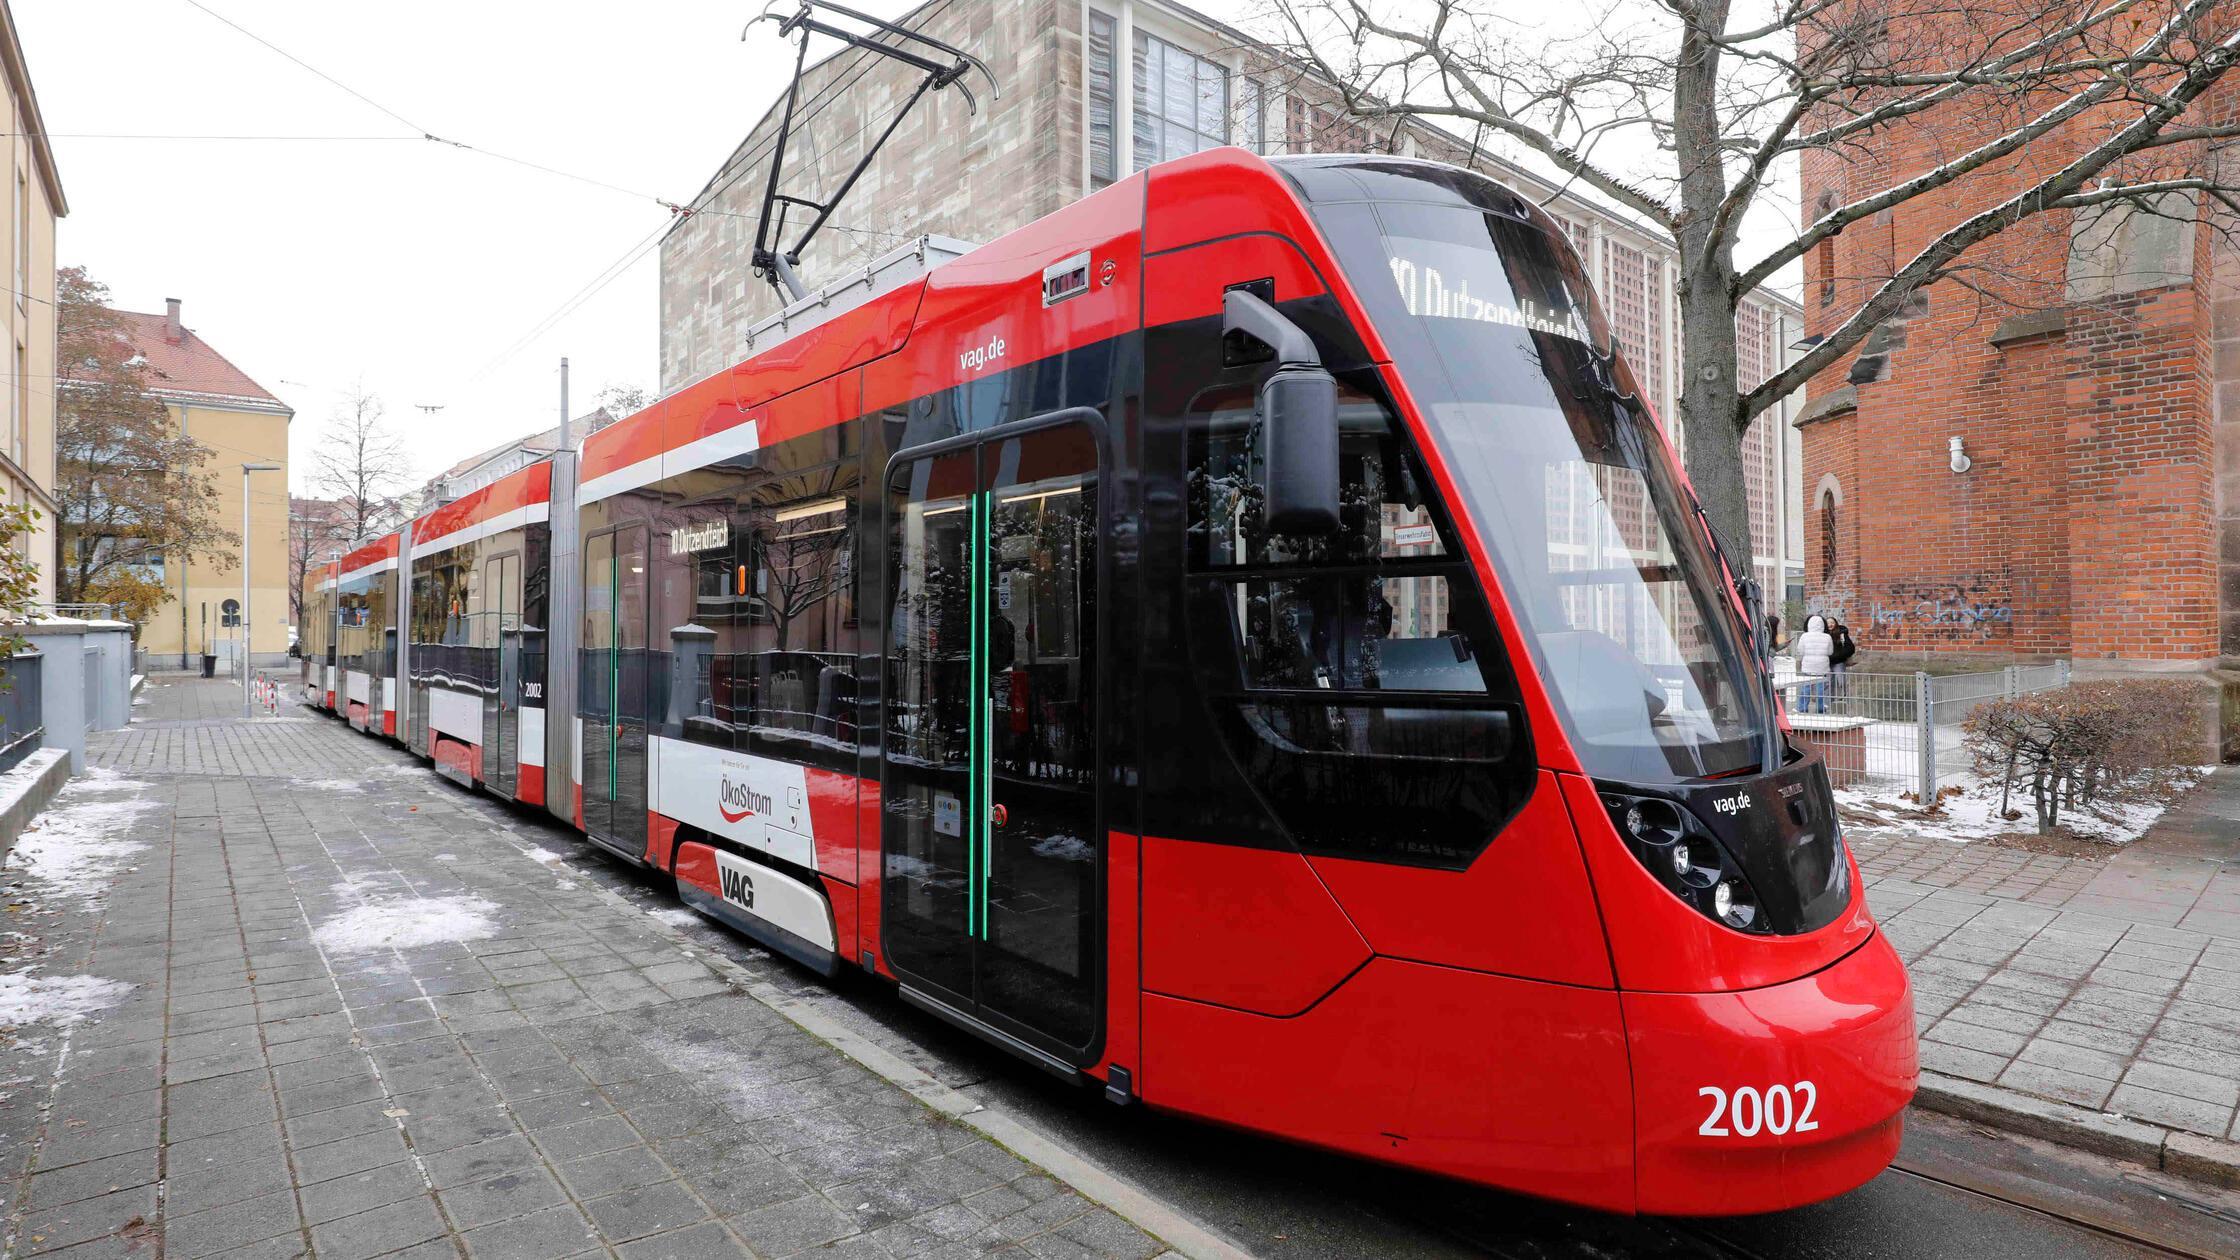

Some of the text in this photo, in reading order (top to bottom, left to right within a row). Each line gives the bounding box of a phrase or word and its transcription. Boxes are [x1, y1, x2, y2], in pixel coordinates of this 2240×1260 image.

[960, 336, 1006, 371] vag.de
[679, 519, 729, 553] Dutzendteich
[525, 682, 542, 698] 2002
[721, 774, 772, 817] ÖkoStrom
[1713, 790, 1751, 816] vag.de
[721, 865, 754, 909] VAG
[1698, 1080, 1819, 1138] 2002
